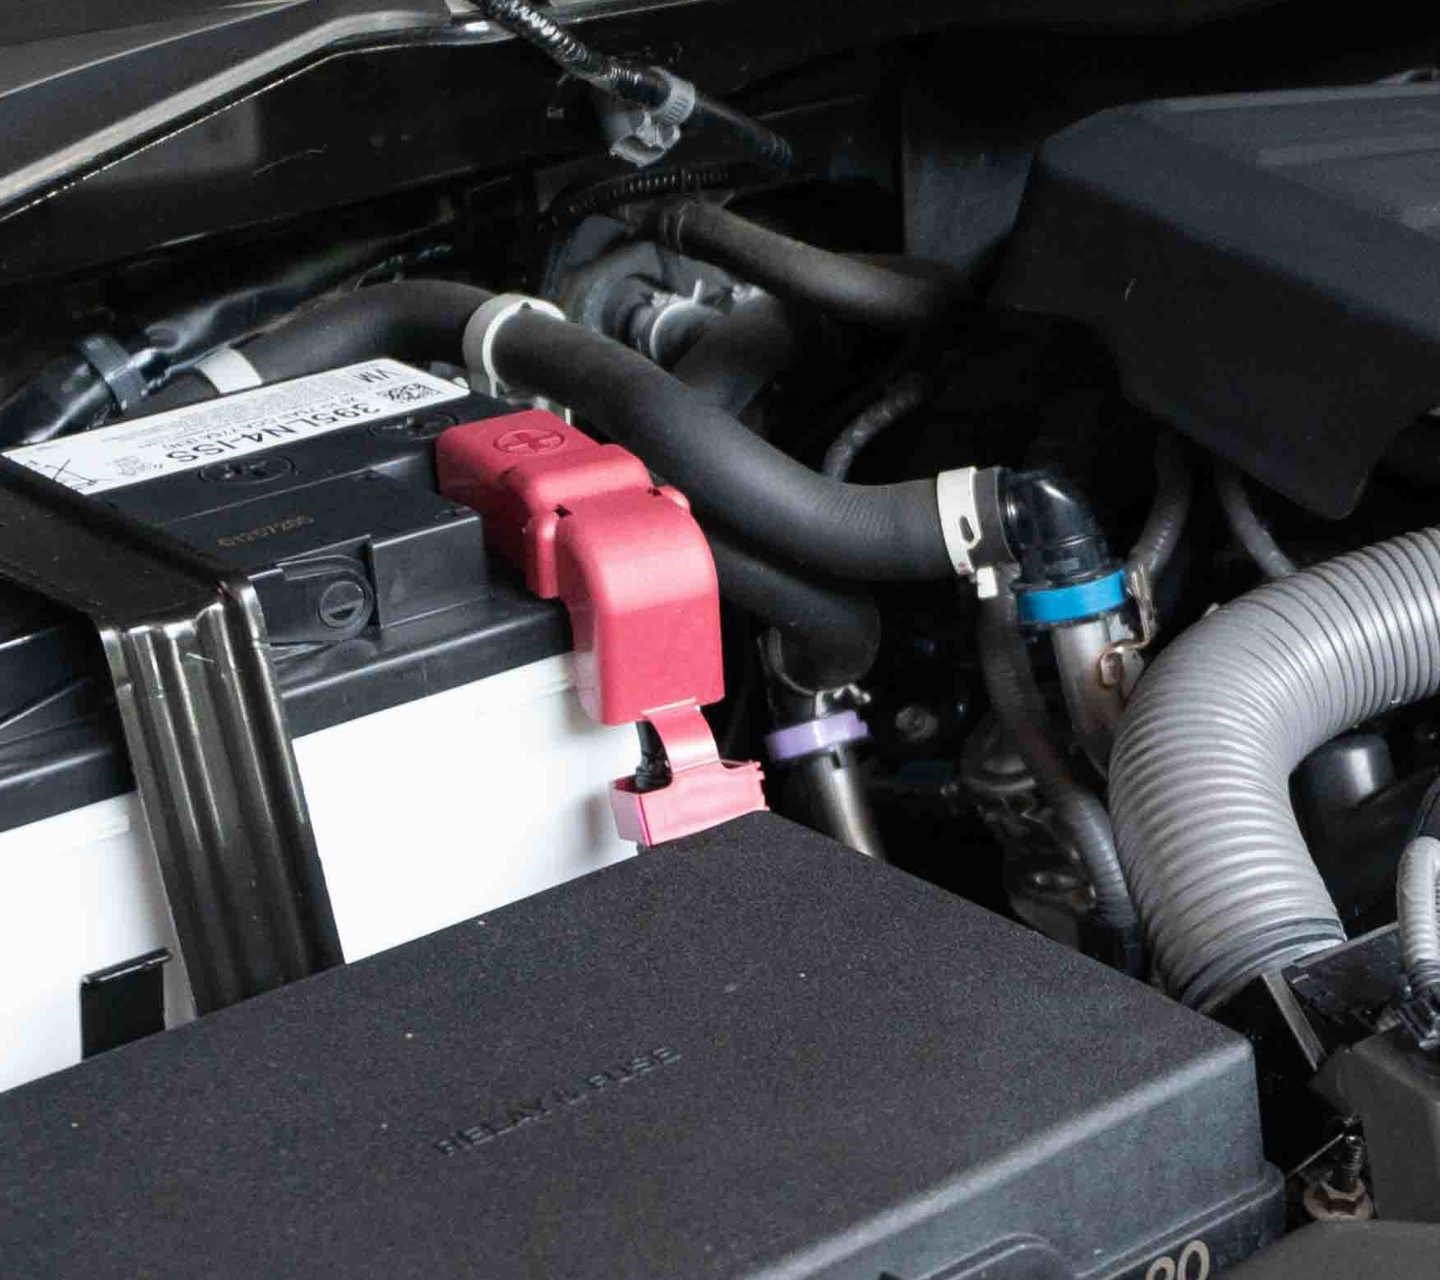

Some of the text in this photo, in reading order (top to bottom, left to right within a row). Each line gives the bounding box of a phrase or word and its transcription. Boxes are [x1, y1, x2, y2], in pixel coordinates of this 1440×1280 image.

[164, 402, 382, 465] 395LN4-ISS
[433, 1094, 552, 1158] RELAY
[586, 1045, 682, 1094] FUSE
